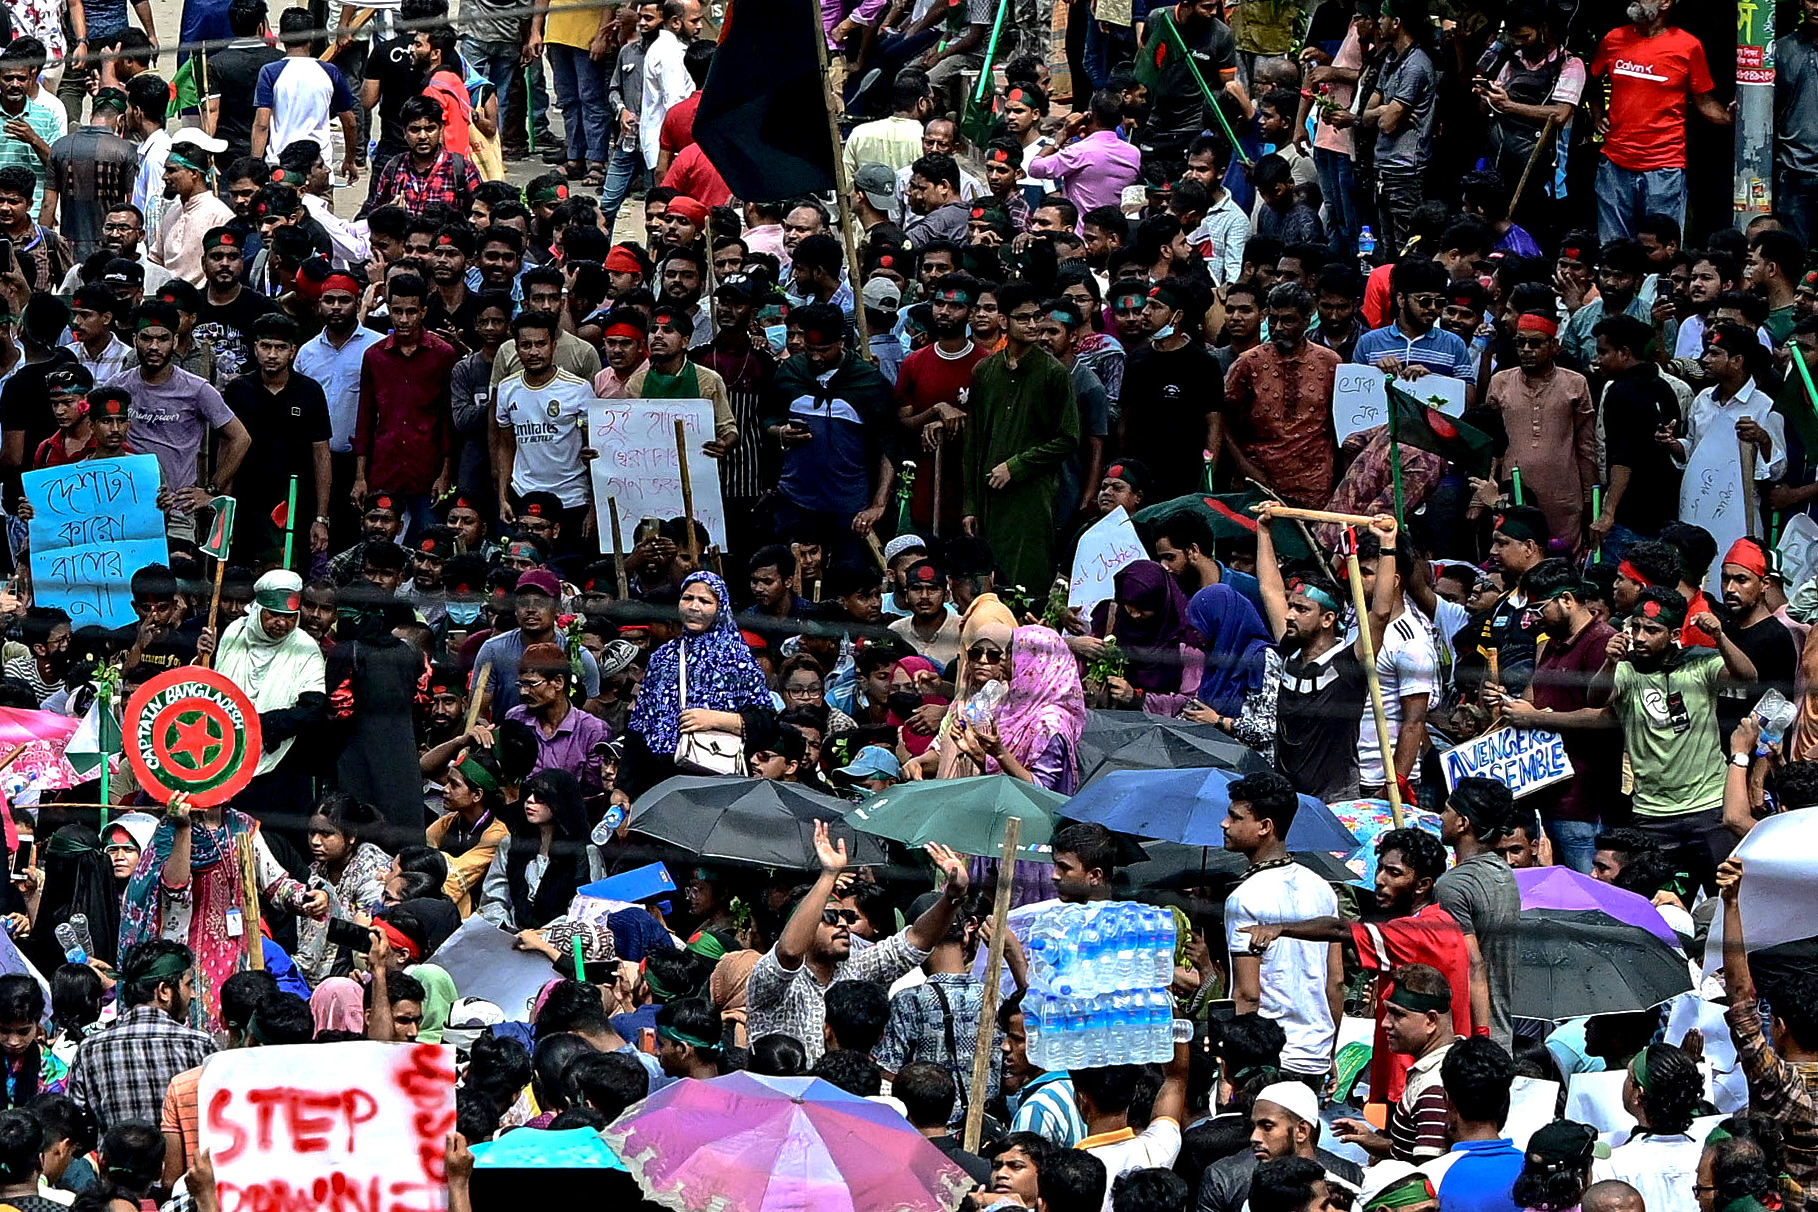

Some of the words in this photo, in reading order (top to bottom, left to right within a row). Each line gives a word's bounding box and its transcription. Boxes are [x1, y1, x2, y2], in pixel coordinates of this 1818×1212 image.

[1615, 59, 1645, 74] Calvin
[137, 696, 163, 770] CAPTAIN
[165, 683, 244, 730] BANGLADESH
[207, 1085, 379, 1167] STEP
